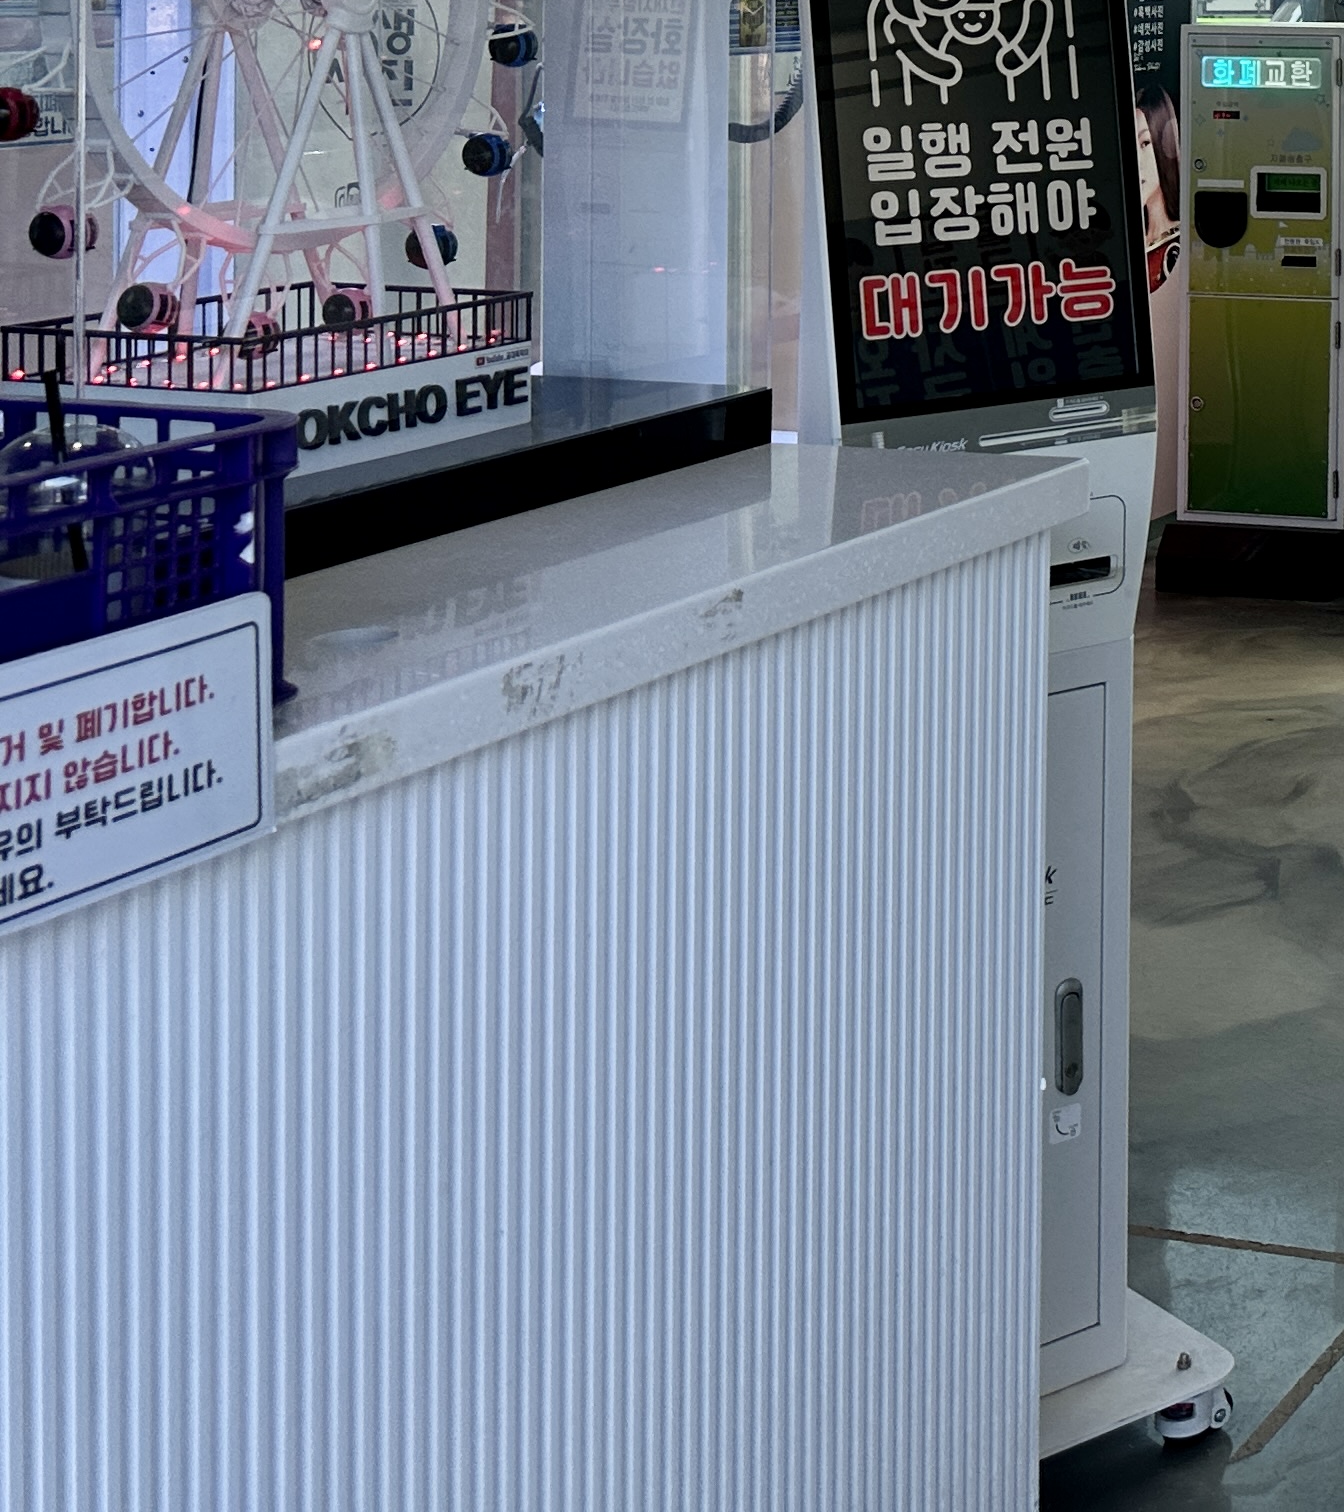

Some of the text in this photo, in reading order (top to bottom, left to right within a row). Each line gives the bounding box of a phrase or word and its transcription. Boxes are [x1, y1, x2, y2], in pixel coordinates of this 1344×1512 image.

[1212, 58, 1313, 88] 화폐교환
[862, 116, 1095, 183] 일행 전원
[870, 178, 1098, 248] 입장해야
[858, 257, 1117, 341] 대기가능
[454, 365, 530, 420] EYE
[38, 718, 65, 757] 및
[75, 674, 215, 744] 폐기합니다.
[63, 730, 181, 795] 않습니다.
[55, 759, 224, 840] 부탁드립니다.
